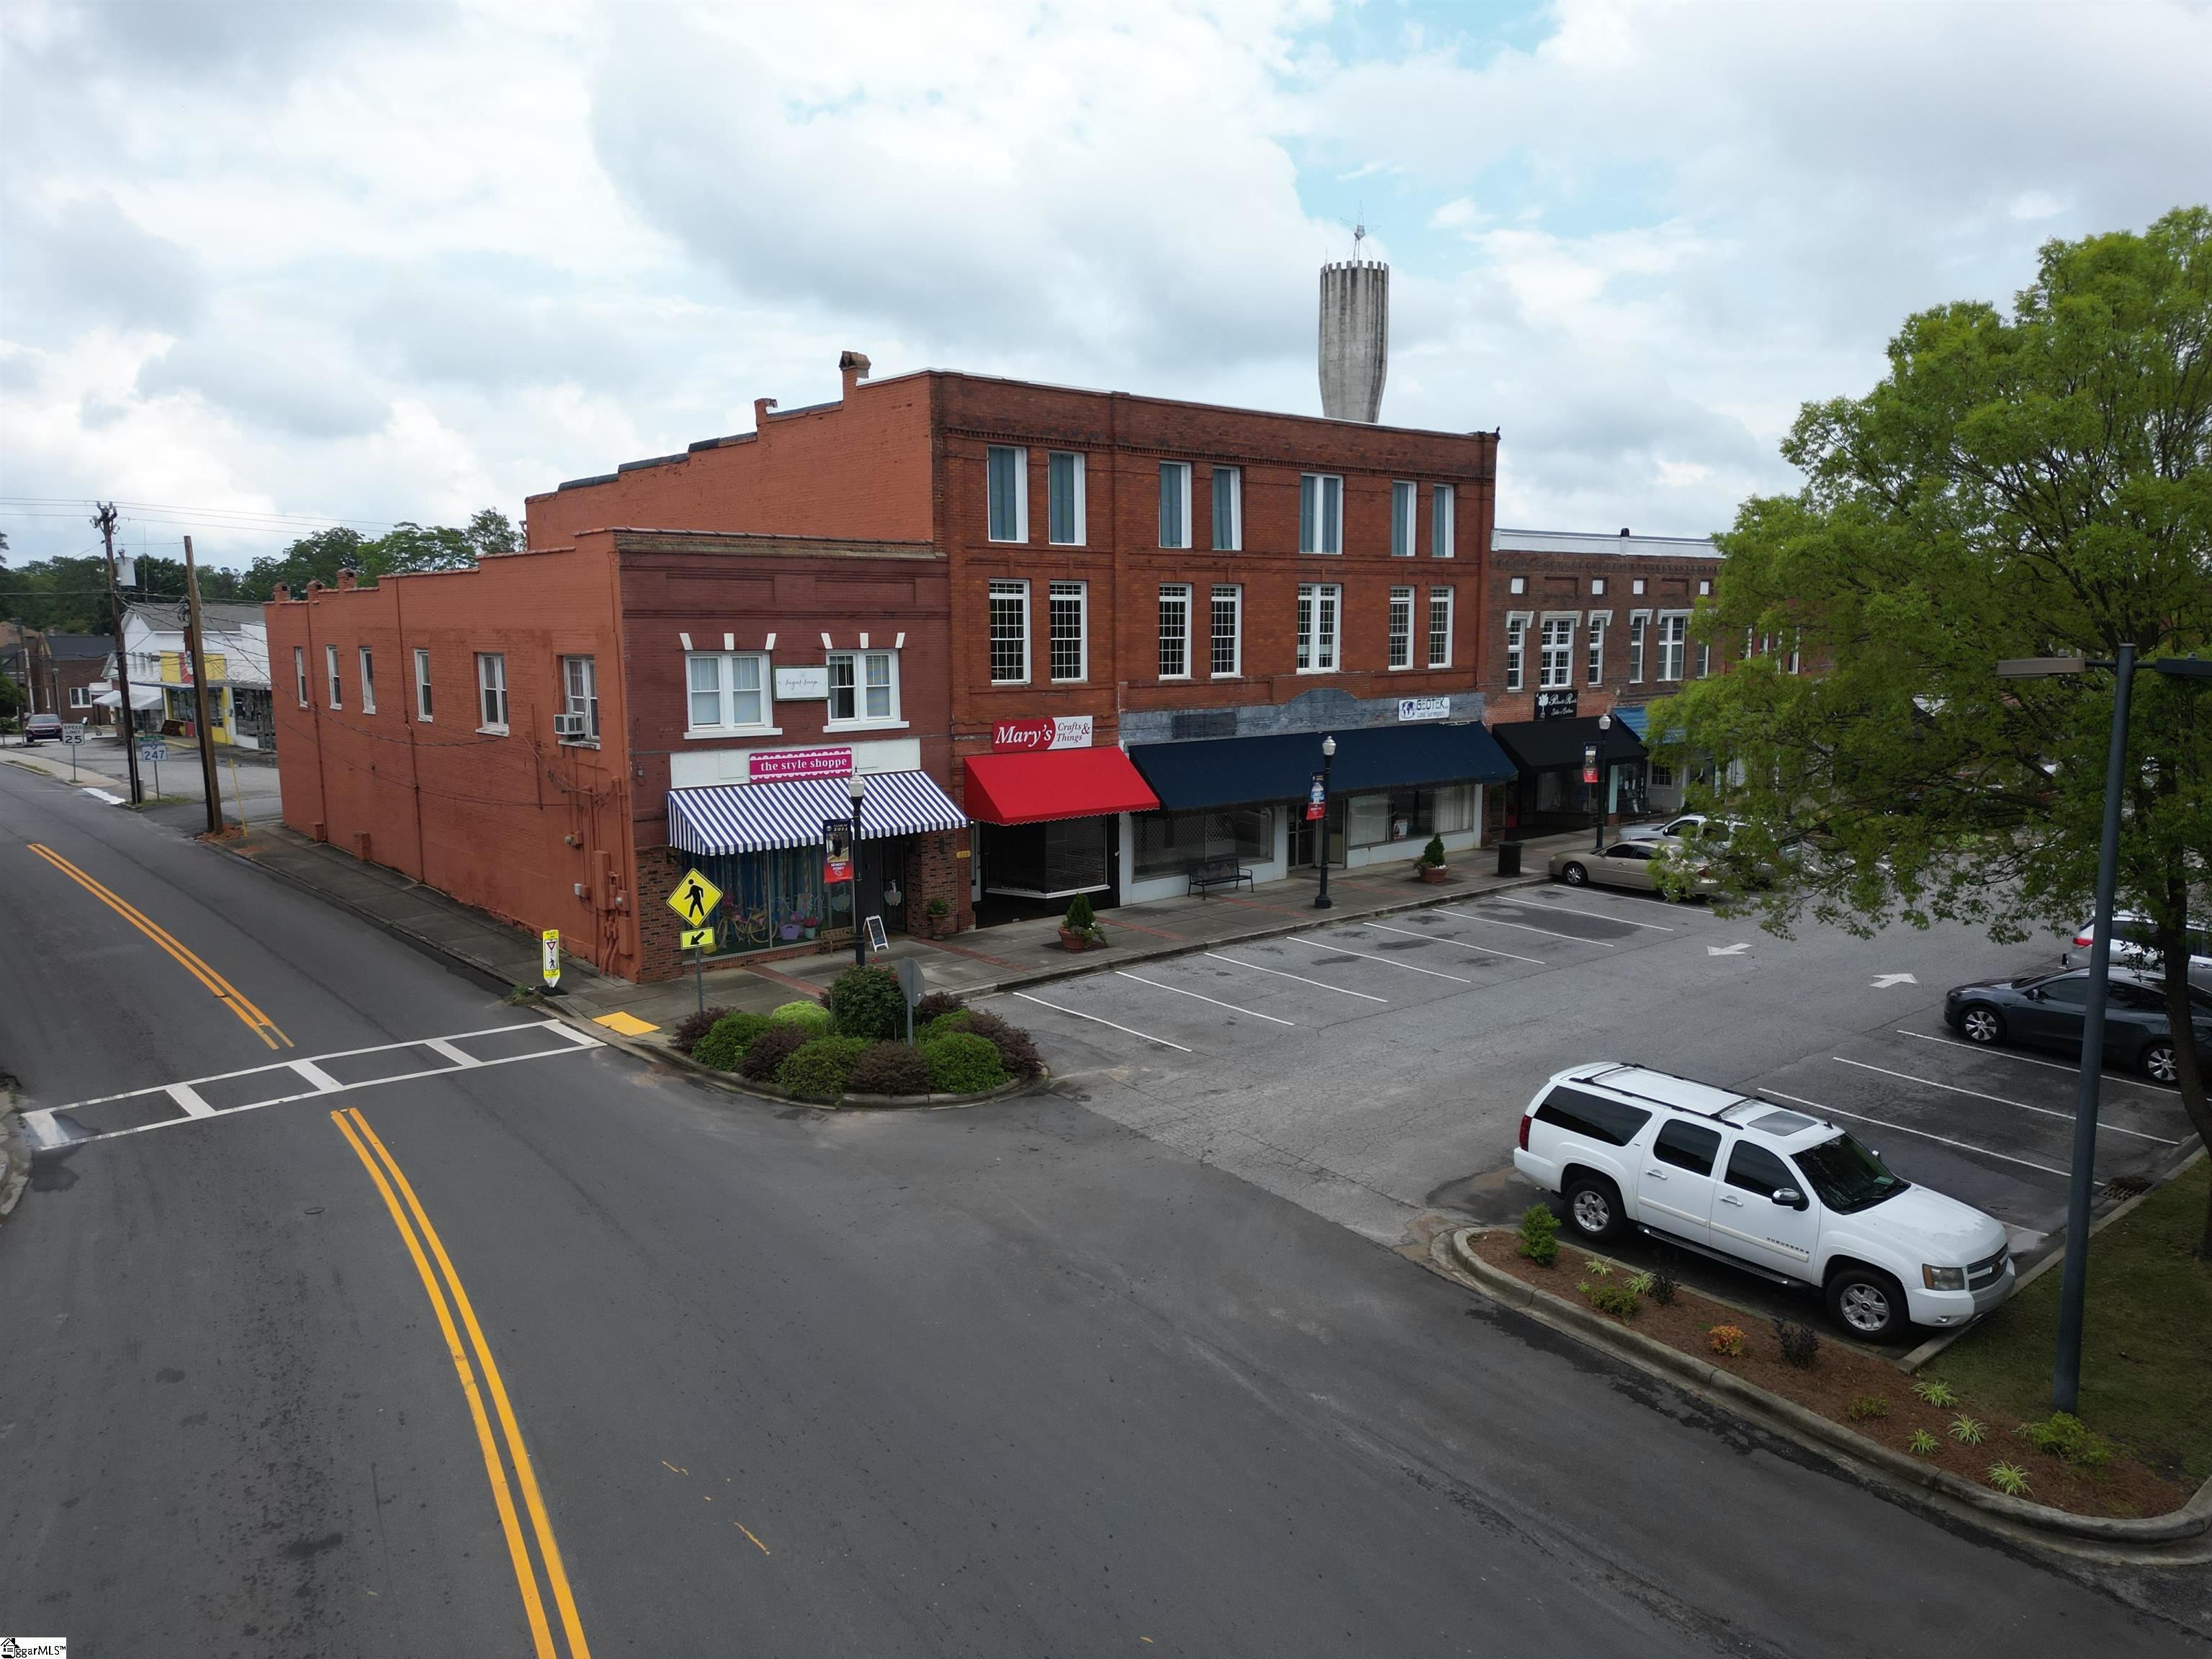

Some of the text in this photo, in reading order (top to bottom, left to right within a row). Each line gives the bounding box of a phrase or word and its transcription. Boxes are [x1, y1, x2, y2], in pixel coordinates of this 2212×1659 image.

[1416, 698, 1445, 711] GEOTEK
[1058, 722, 1090, 734] Crafts &
[65, 735, 82, 744] 25
[994, 724, 1052, 747] Mary's
[1057, 733, 1082, 743] Things
[144, 750, 165, 760] 247
[760, 757, 848, 771] the style shoppe
[1766, 1237, 1804, 1252] SUBURBAN
